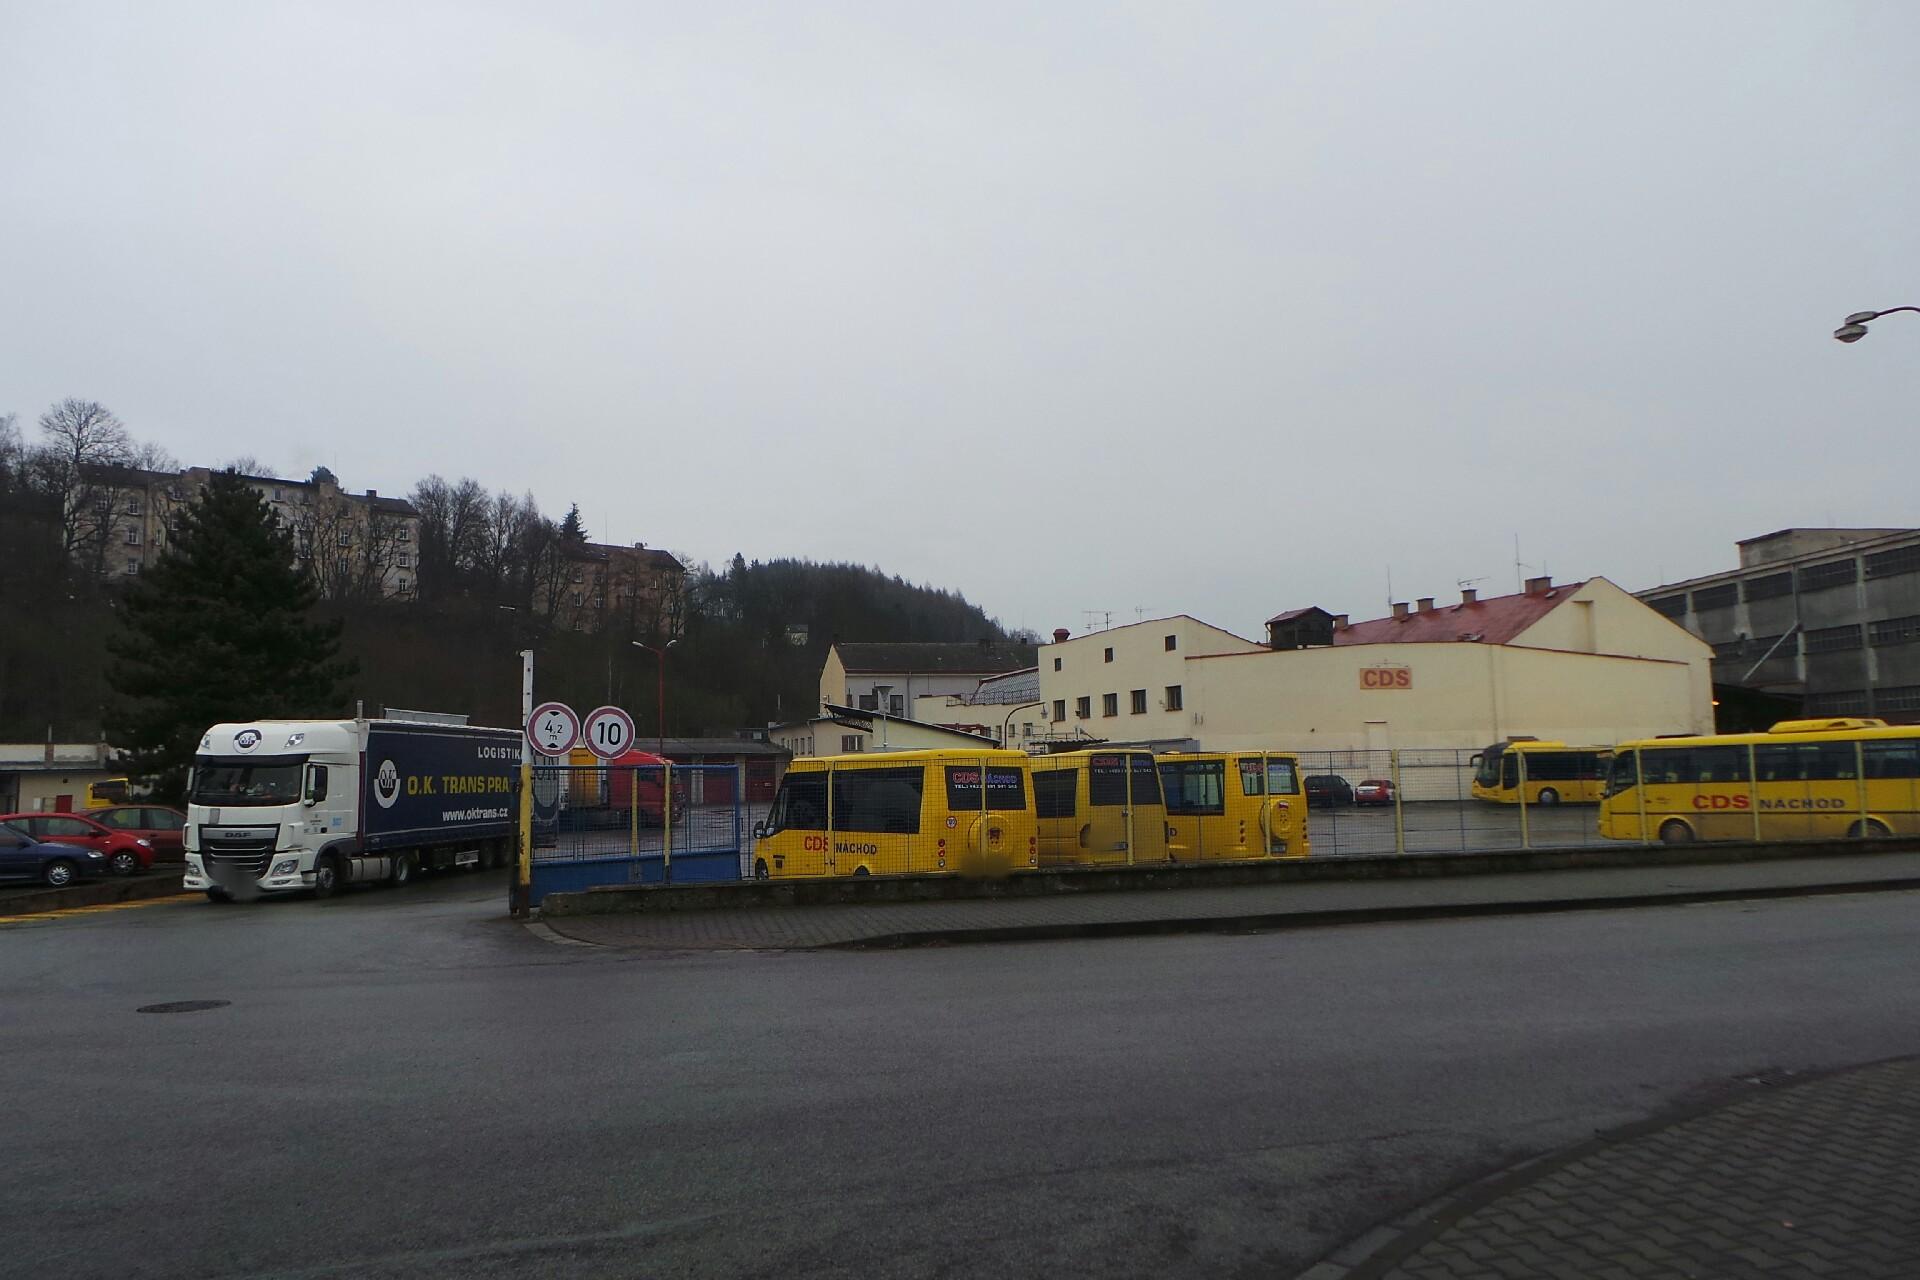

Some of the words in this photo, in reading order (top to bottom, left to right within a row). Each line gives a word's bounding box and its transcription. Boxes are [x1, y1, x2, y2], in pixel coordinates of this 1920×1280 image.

[1363, 669, 1409, 687] CDS
[545, 720, 563, 734] 4,2
[597, 721, 622, 746] 10
[407, 775, 437, 795] O.K.
[442, 776, 485, 794] TRANS
[487, 776, 510, 793] PRA
[952, 771, 980, 784] CDS
[1692, 794, 1750, 809] CDS
[442, 807, 509, 822] www.oktrans.cz
